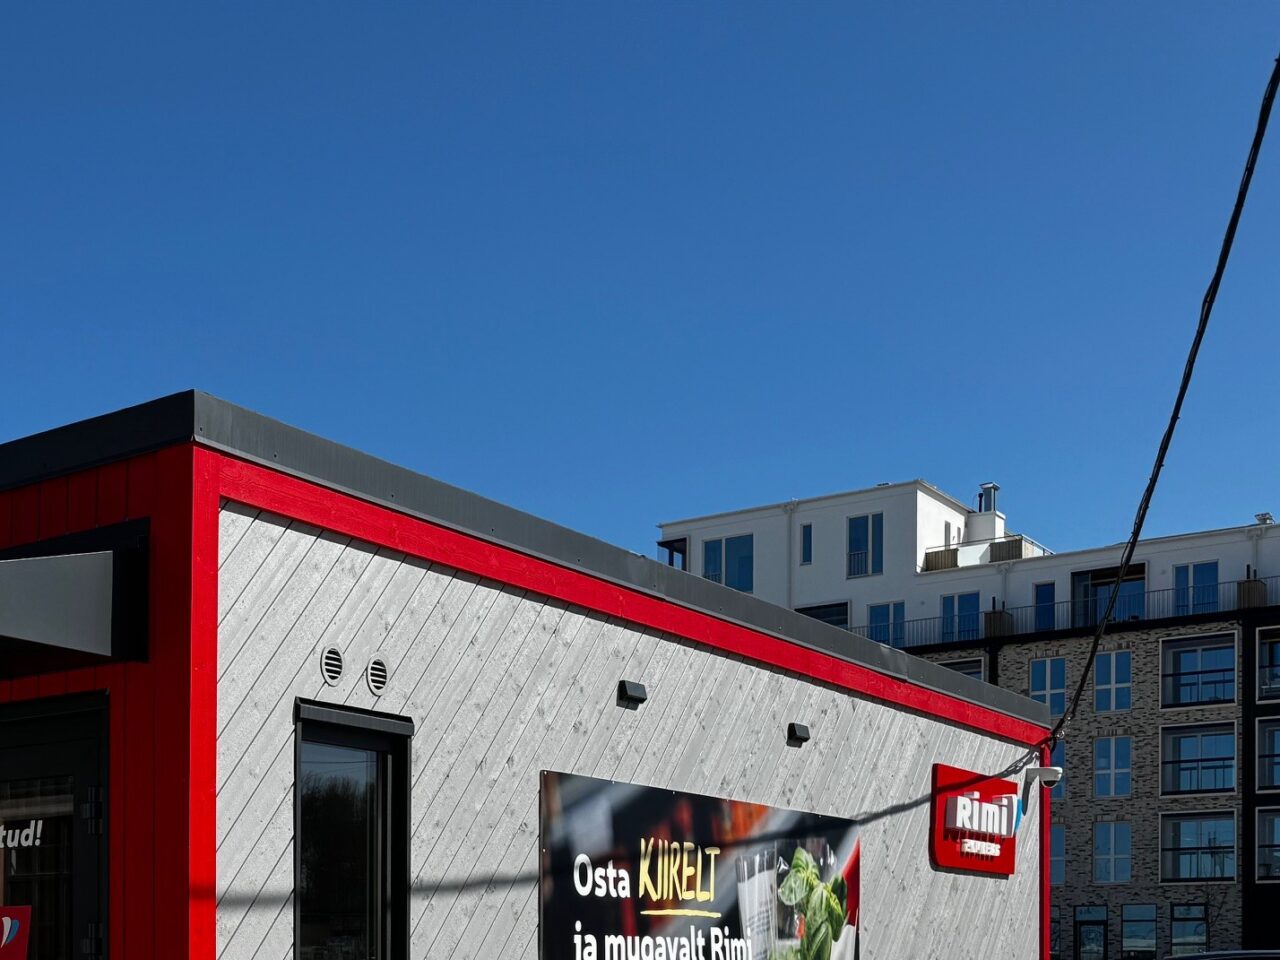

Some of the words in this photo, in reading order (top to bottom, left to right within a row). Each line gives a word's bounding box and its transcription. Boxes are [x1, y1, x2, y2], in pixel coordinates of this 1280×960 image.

[950, 791, 1010, 837] Rimi
[573, 853, 631, 898] Osta
[638, 837, 721, 903] KIIRELT
[961, 838, 1001, 857] EXPRESS
